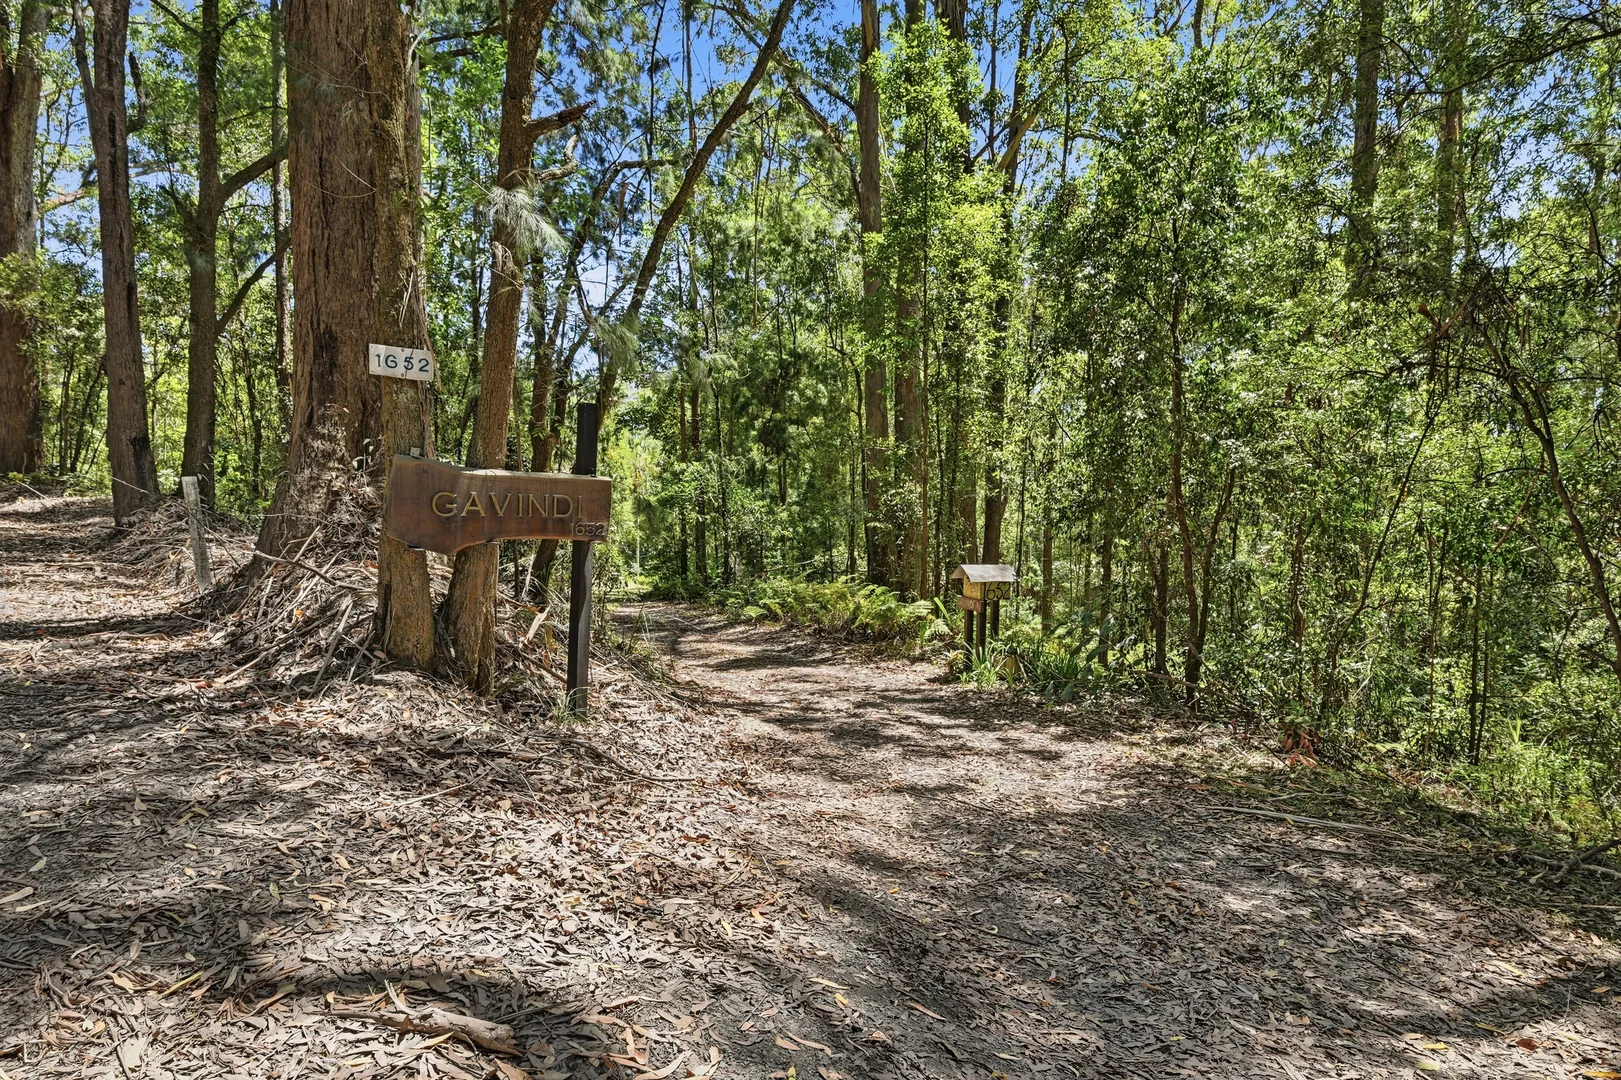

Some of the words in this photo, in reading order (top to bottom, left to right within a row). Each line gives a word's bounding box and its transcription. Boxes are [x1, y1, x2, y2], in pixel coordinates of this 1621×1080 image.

[375, 353, 430, 373] 1652
[431, 491, 583, 518] GAVINDI
[570, 521, 605, 536] 1652
[982, 581, 1011, 600] 1652
